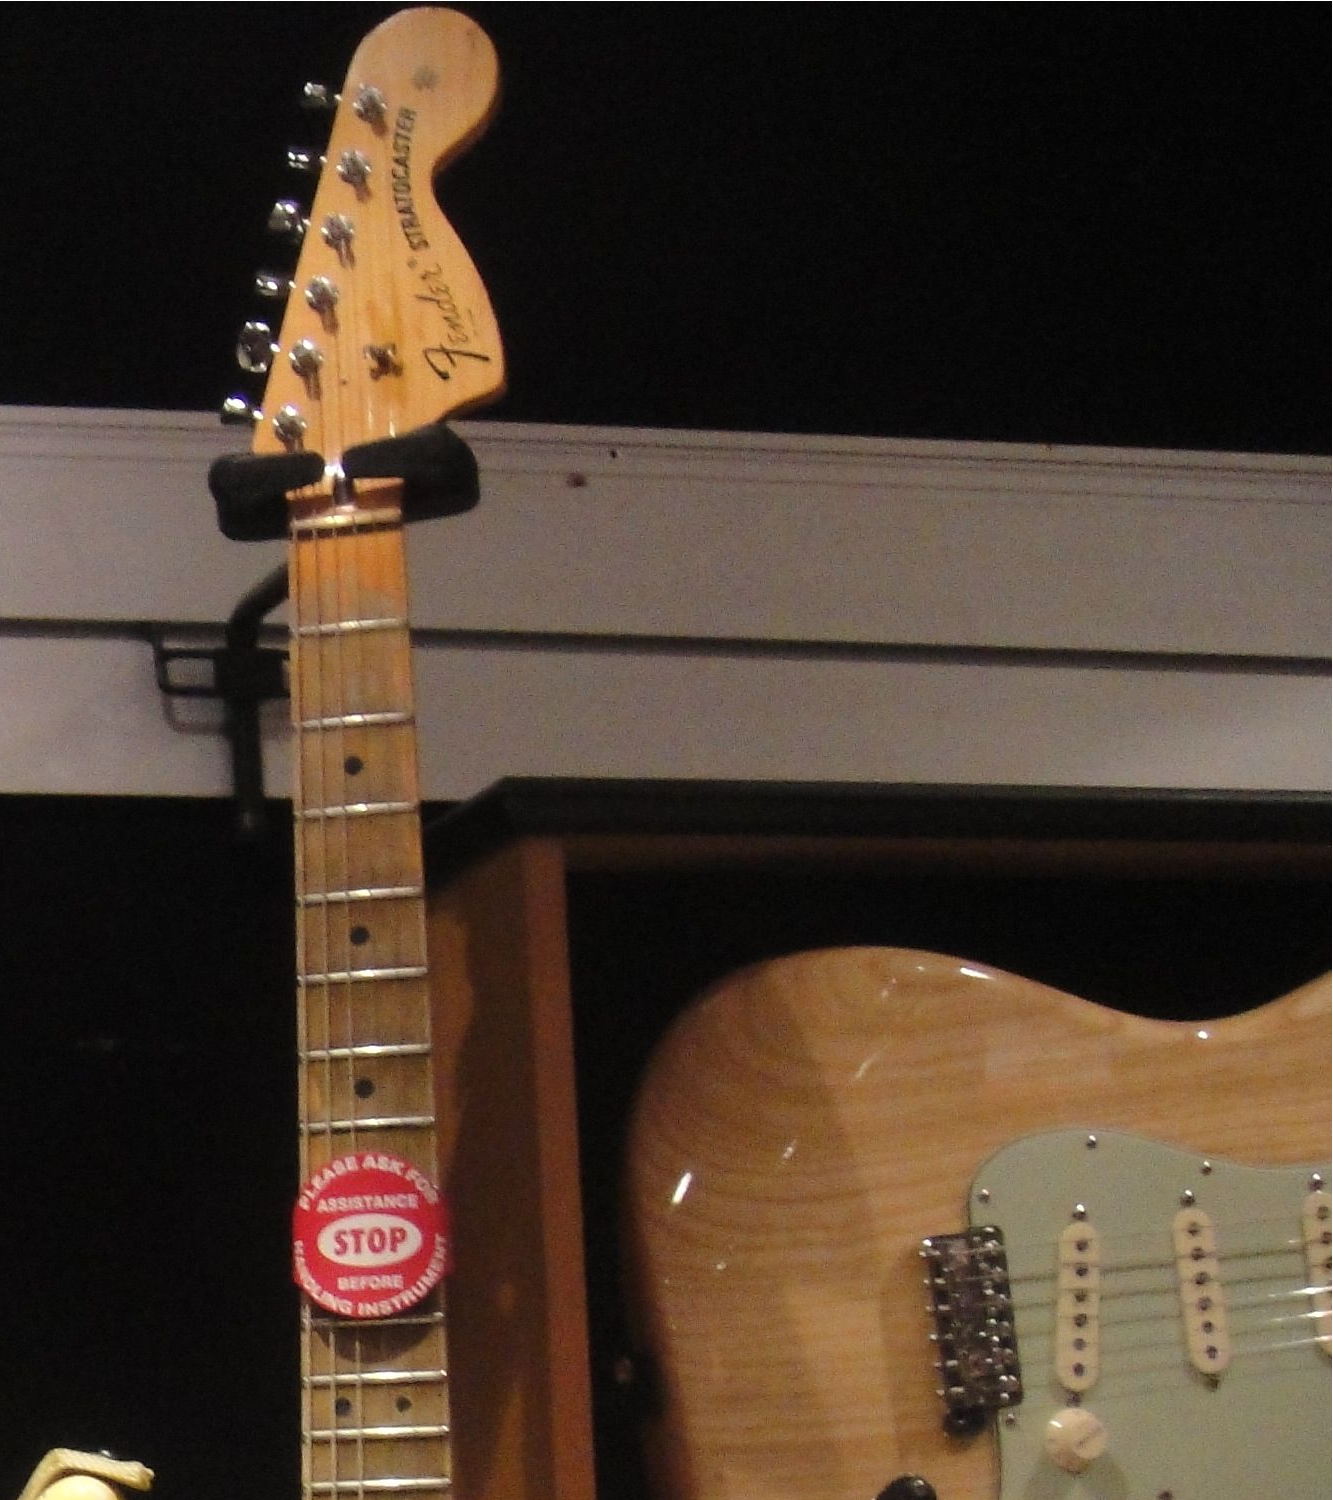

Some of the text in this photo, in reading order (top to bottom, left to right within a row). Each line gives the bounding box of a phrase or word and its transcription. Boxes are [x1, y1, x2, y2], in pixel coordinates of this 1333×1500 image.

[391, 107, 429, 251] STRATOCASTER
[416, 262, 490, 381] Fender
[299, 1154, 439, 1211] PLEASE ASK FOR
[316, 1193, 420, 1213] ASSISTANCE
[334, 1226, 407, 1255] STOP
[337, 1274, 404, 1291] BEFORE
[357, 1233, 447, 1317] INSTRUMENT
